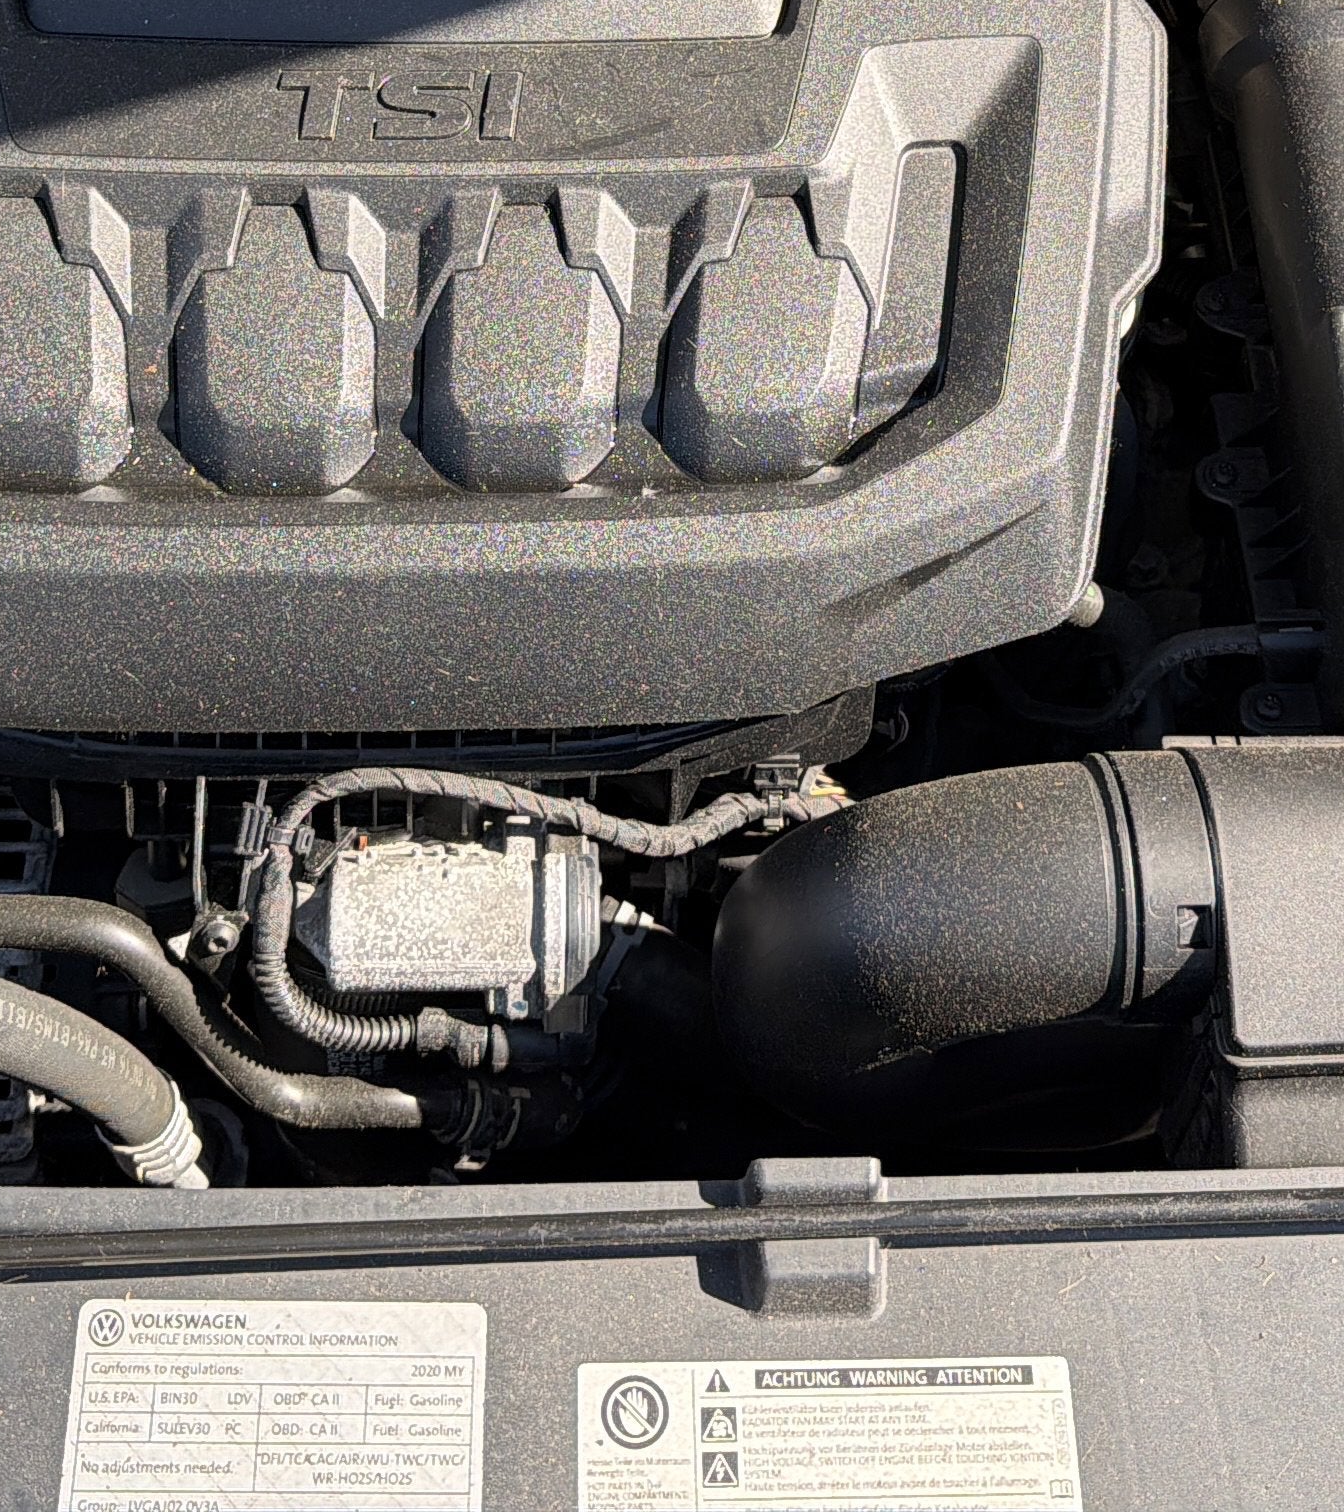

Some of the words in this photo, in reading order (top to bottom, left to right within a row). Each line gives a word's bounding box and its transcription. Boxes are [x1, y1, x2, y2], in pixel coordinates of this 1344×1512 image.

[276, 68, 526, 143] TSI
[131, 1313, 247, 1330] VOLKSWAGEN
[129, 1333, 180, 1345] VEHICLE
[183, 1333, 244, 1346] EMISSION
[247, 1334, 306, 1346] CONTROL
[309, 1334, 399, 1347] INFORMATION
[91, 1361, 151, 1374] Conforms
[154, 1363, 167, 1374] to
[170, 1362, 243, 1379] regulations:
[411, 1365, 441, 1377] 2020
[444, 1365, 465, 1378] MY
[762, 1371, 840, 1387] ACHTUNG
[849, 1370, 928, 1386] WARNING
[936, 1368, 1022, 1384] ATTENTION
[88, 1392, 111, 1404] U.S.
[160, 1392, 198, 1405] BIN30
[227, 1393, 254, 1405] LDV
[310, 1393, 329, 1406] CA
[409, 1393, 464, 1407] Gasoline
[157, 1422, 211, 1435] SULEV30
[225, 1423, 242, 1435] PC
[309, 1423, 327, 1436] CA
[408, 1424, 462, 1437] Gasoline
[81, 1460, 99, 1474] No
[101, 1460, 180, 1477] adjustments
[184, 1461, 233, 1474] needed.
